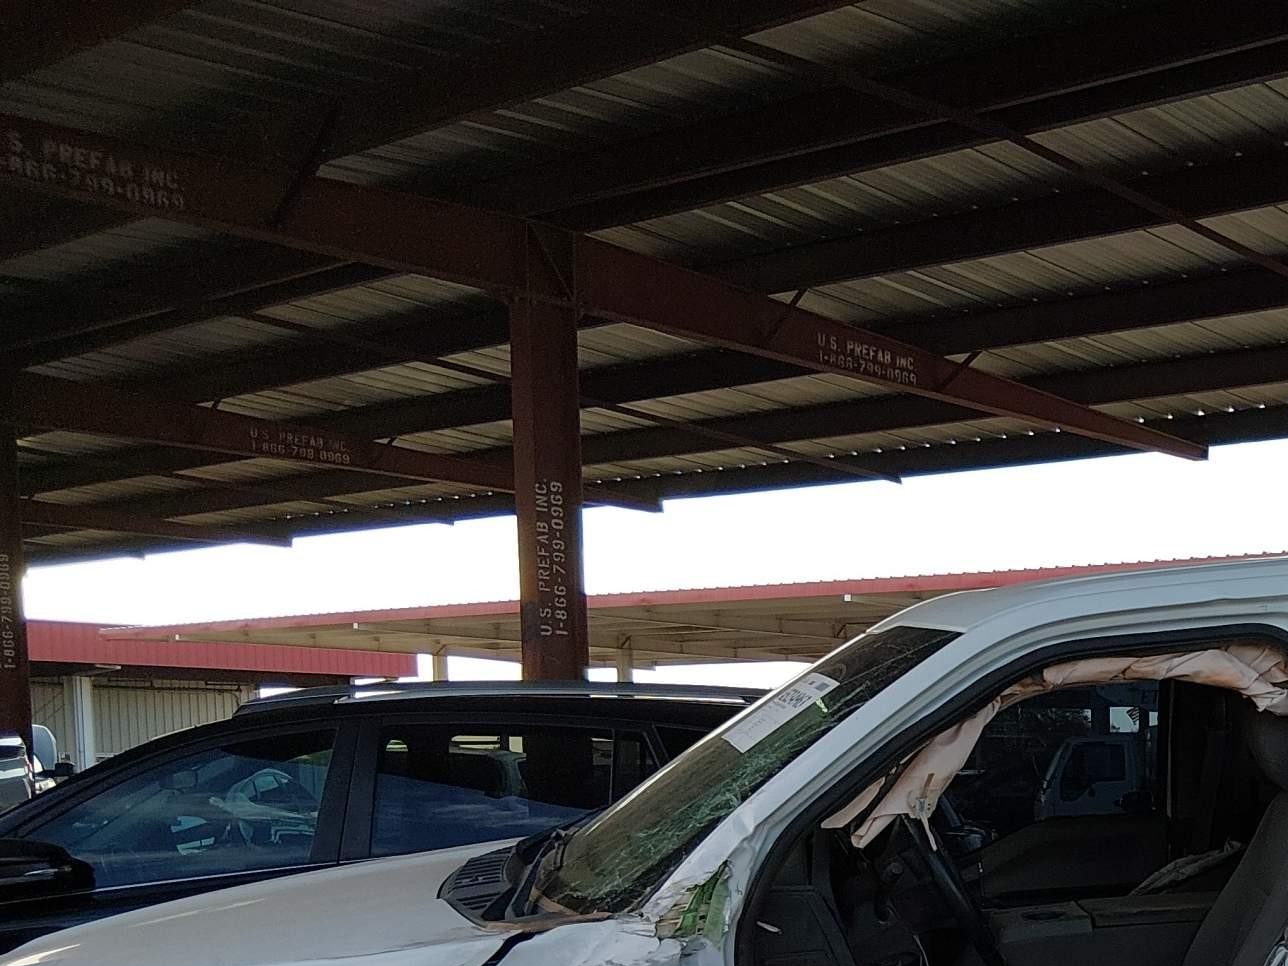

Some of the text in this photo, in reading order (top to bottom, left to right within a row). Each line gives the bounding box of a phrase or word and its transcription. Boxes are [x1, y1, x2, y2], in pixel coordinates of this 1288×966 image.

[846, 340, 892, 364] PREFAB
[535, 478, 553, 636] U.S. PREFAB INC.
[549, 480, 569, 636] 1-866-799-0969
